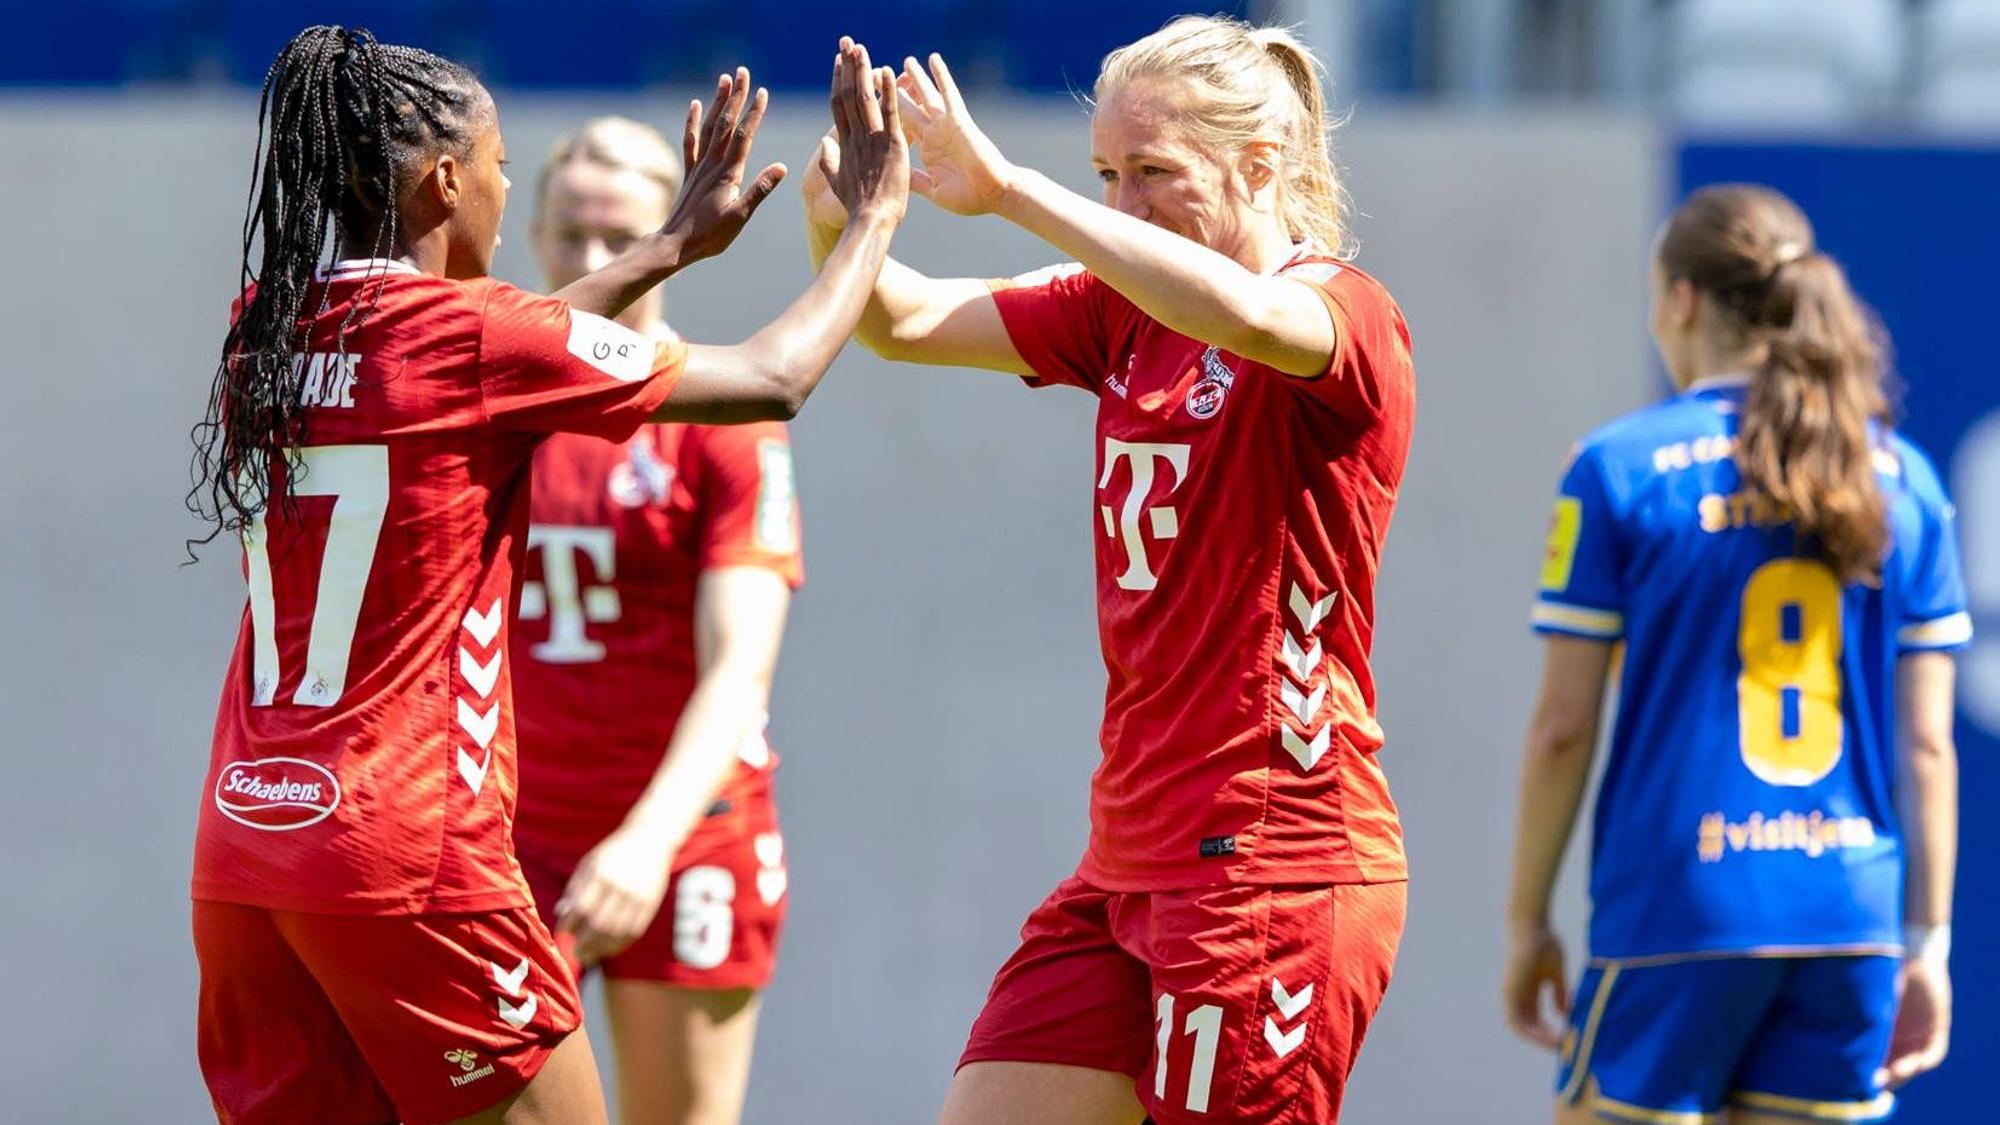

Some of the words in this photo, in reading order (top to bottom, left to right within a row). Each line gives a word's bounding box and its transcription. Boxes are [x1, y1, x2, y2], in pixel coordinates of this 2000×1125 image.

[233, 444, 390, 707] 17
[1737, 558, 1844, 786] 8
[224, 769, 322, 801] Schaebens
[450, 1062, 496, 1088] hummel
[1155, 992, 1224, 1113] 11
